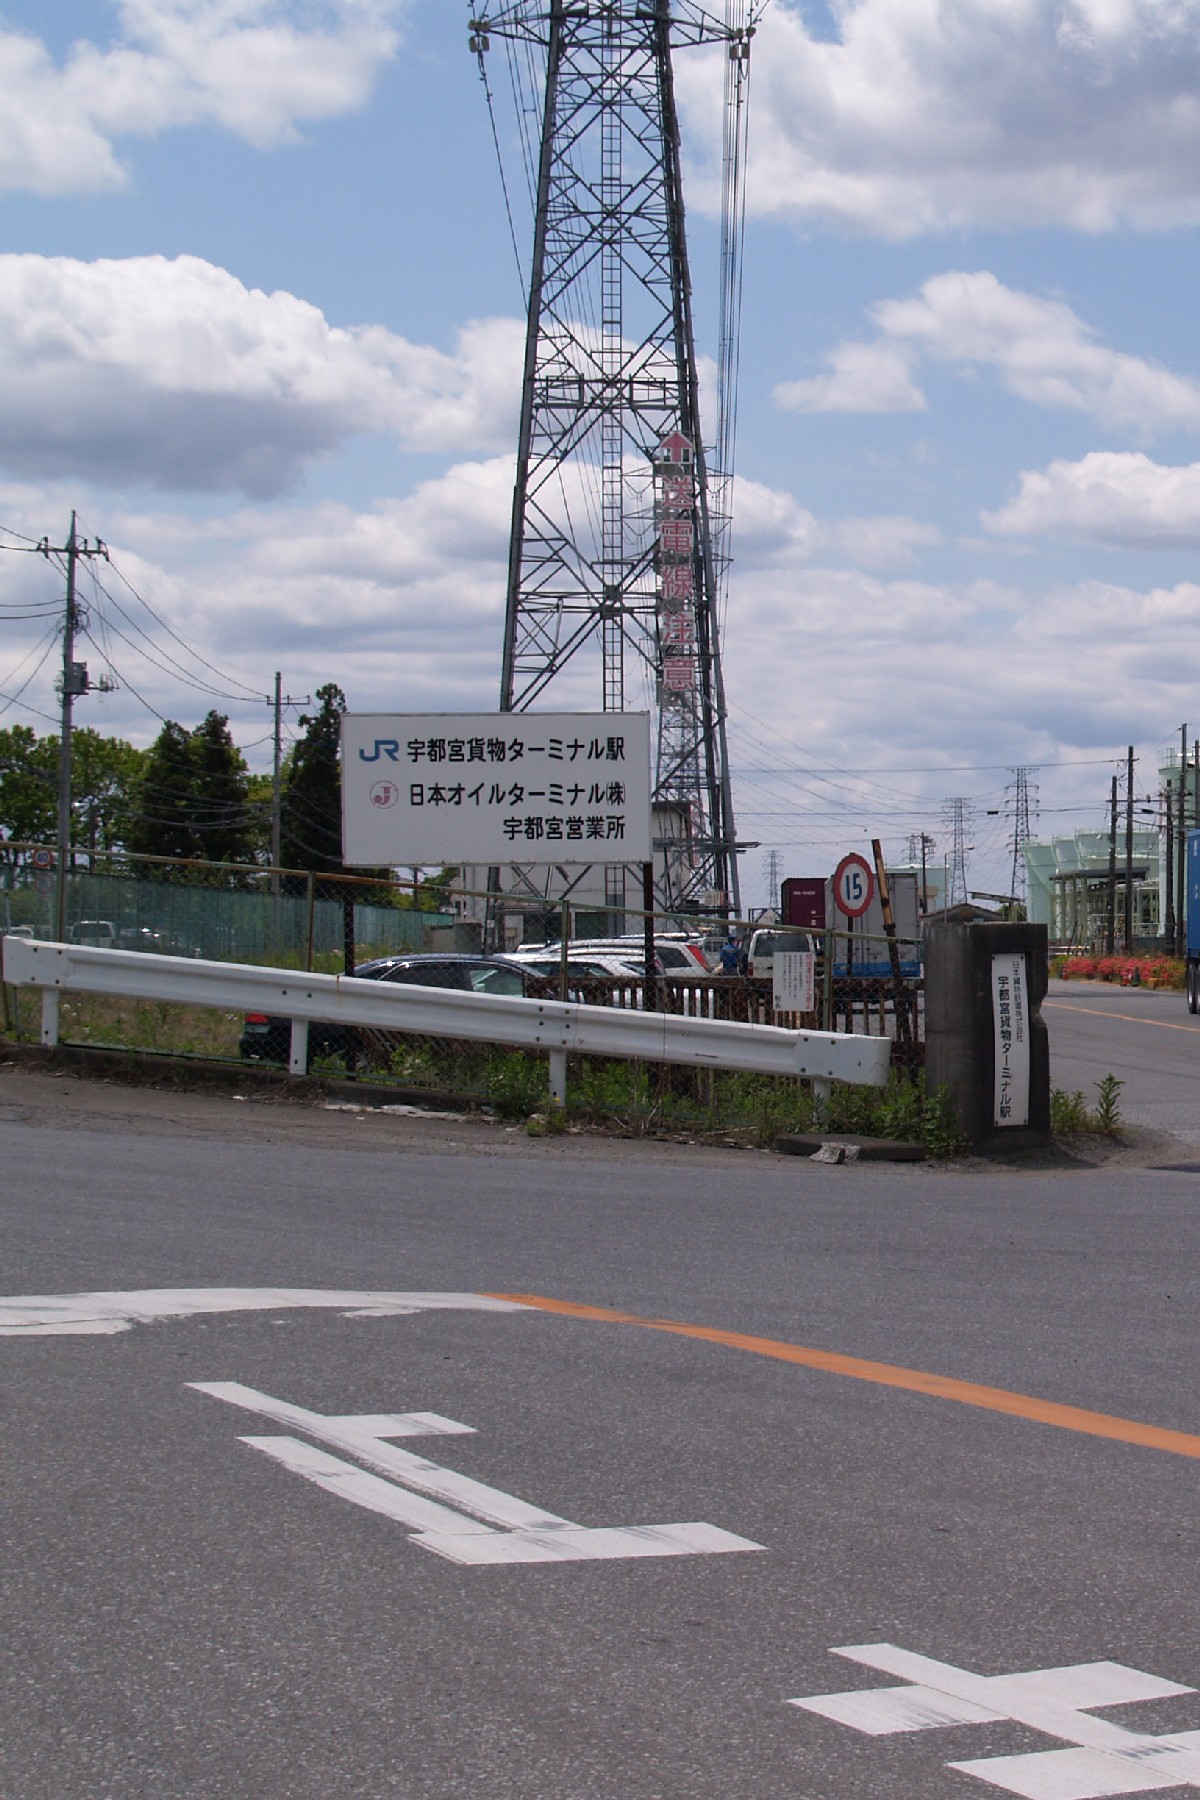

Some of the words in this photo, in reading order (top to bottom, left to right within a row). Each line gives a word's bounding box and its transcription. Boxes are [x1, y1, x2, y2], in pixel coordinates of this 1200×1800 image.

[660, 474, 696, 691] 送電線注意
[359, 740, 399, 762] JR
[407, 737, 626, 763] 宇都宮貨物ターミナル駅
[502, 815, 626, 841] 宇都宮営業所
[844, 872, 863, 901] 15
[997, 976, 1013, 1119] 宇都宮貨物ターミナル駅
